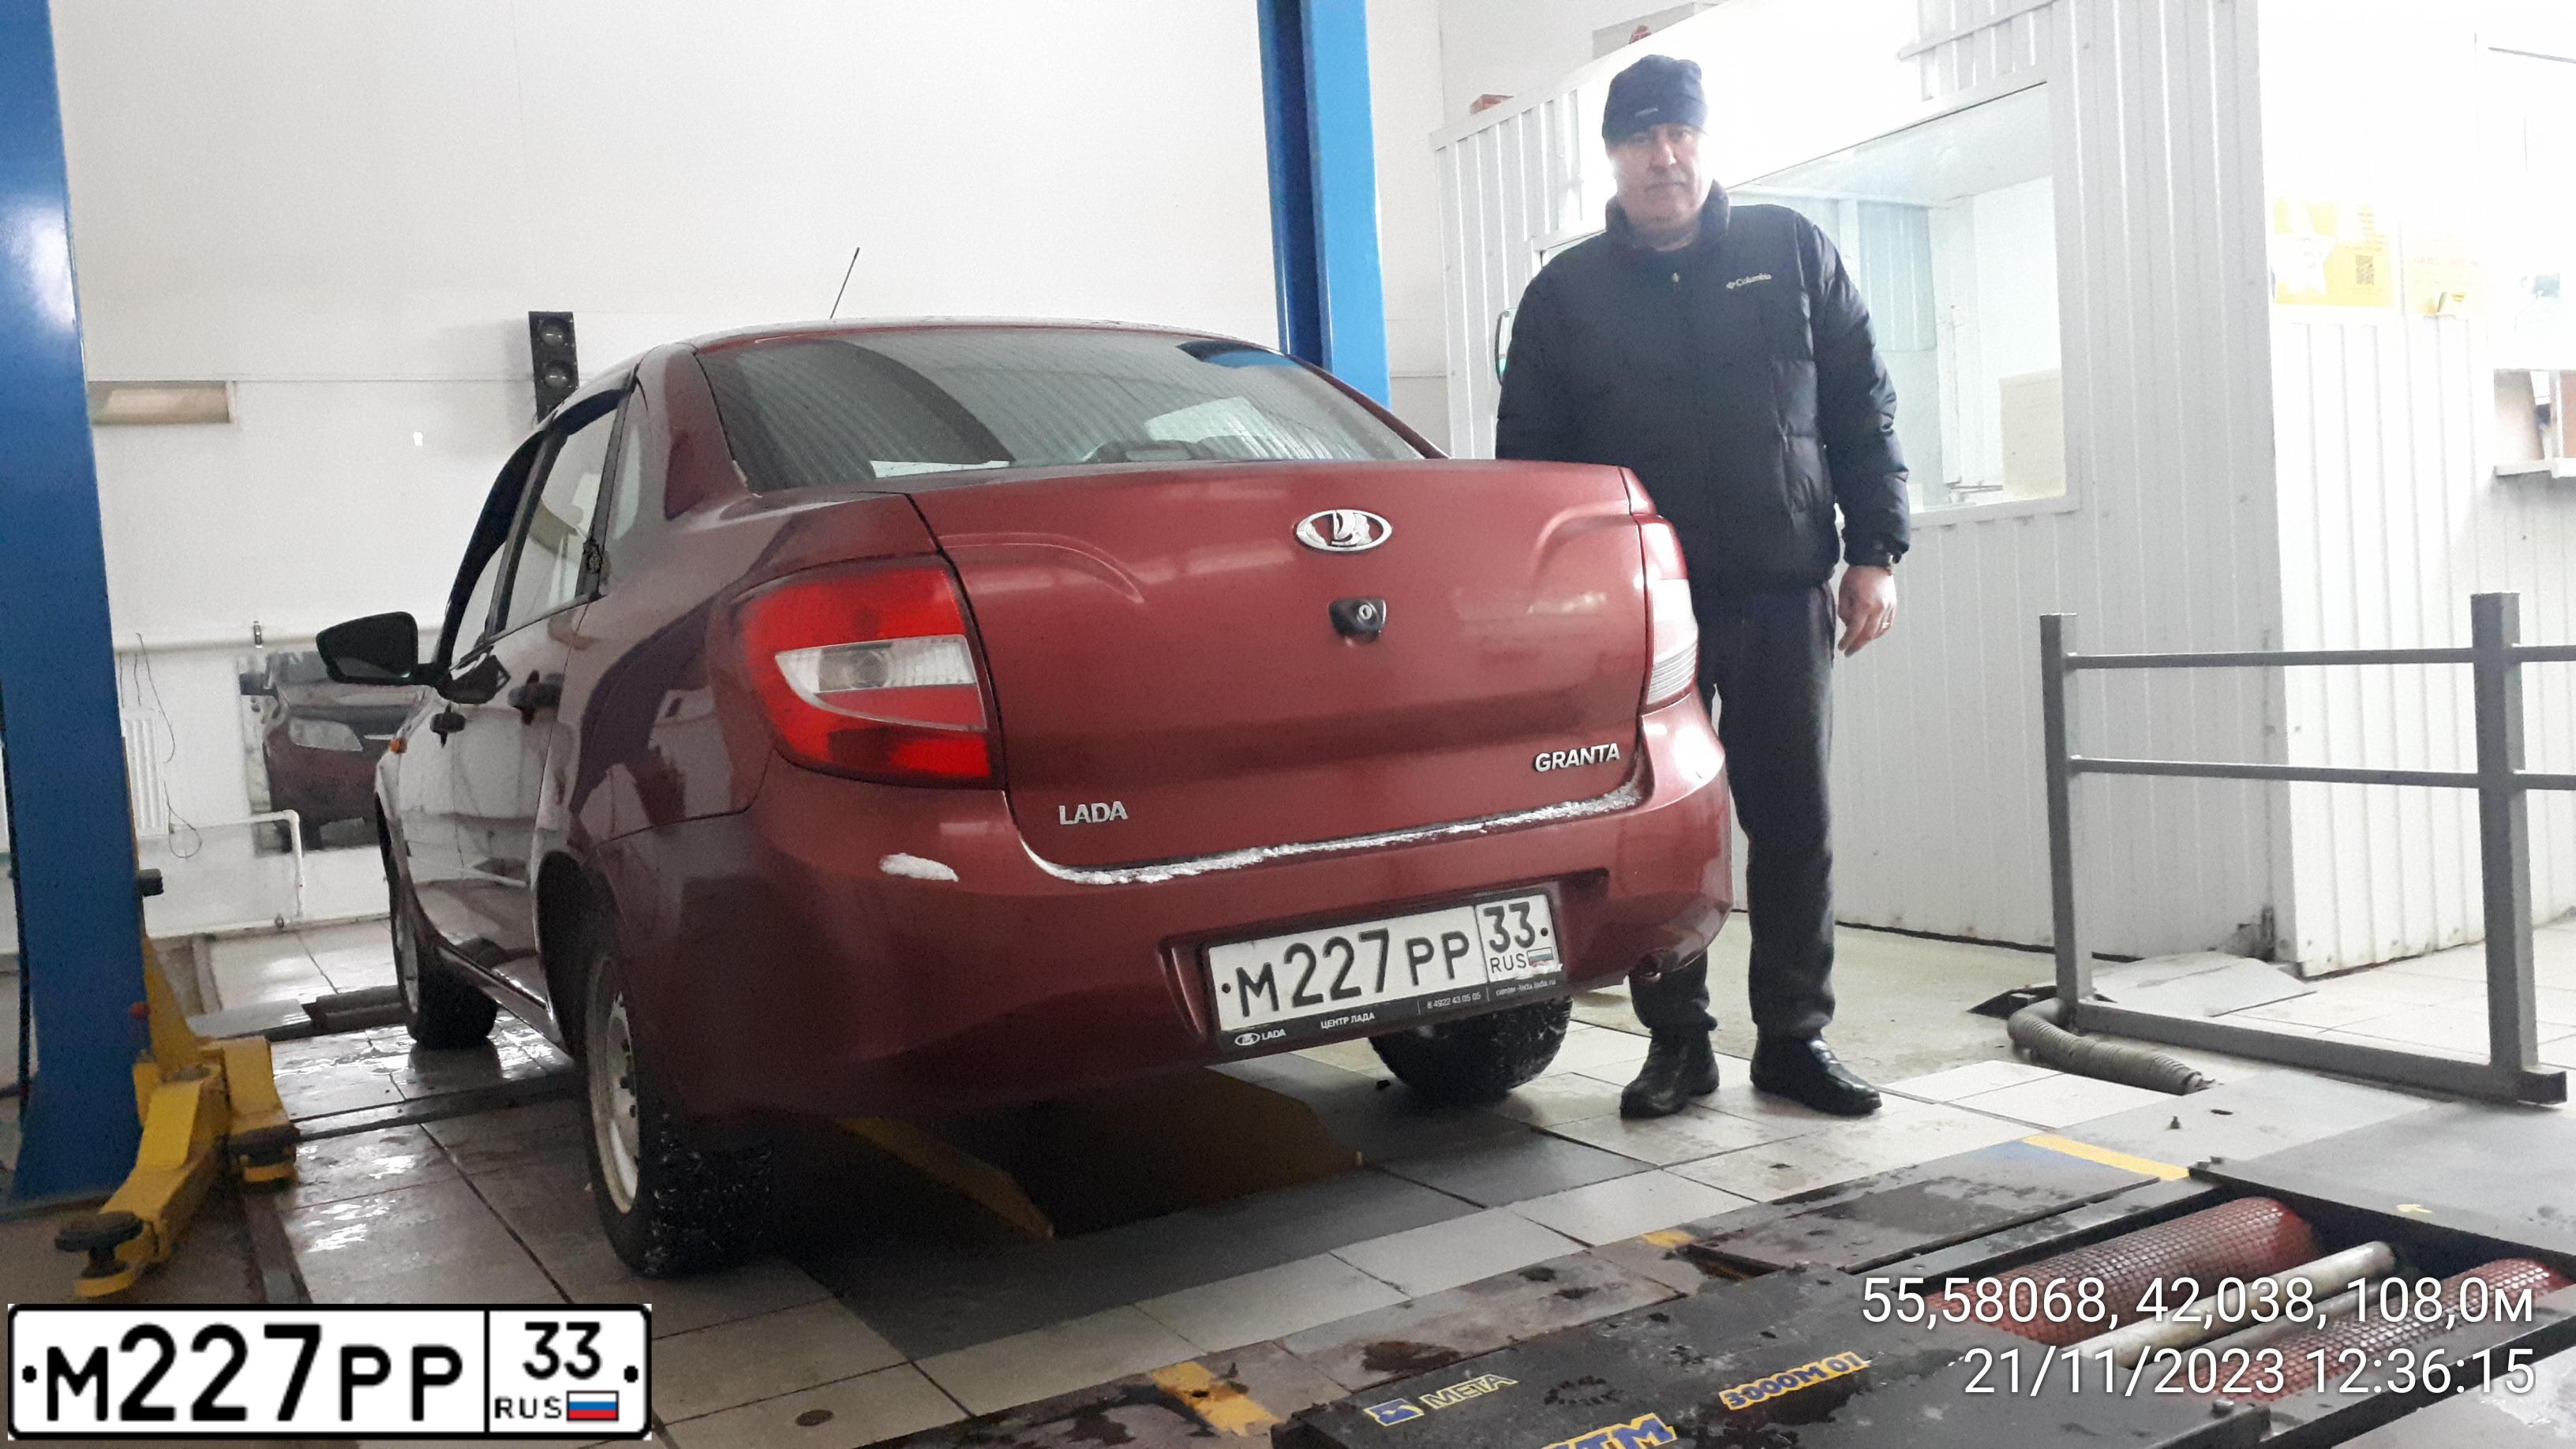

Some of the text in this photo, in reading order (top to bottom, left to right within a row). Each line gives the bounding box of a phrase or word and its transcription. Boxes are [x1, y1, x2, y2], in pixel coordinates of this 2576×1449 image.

[1533, 742, 1621, 773] GRANTA
[1058, 799, 1129, 826] LADA
[1483, 902, 1536, 953] 33
[1489, 952, 1528, 975] RUS
[1320, 1011, 1376, 1030] ЦЕНТР ЛАДА
[1261, 1028, 1286, 1042] LADA
